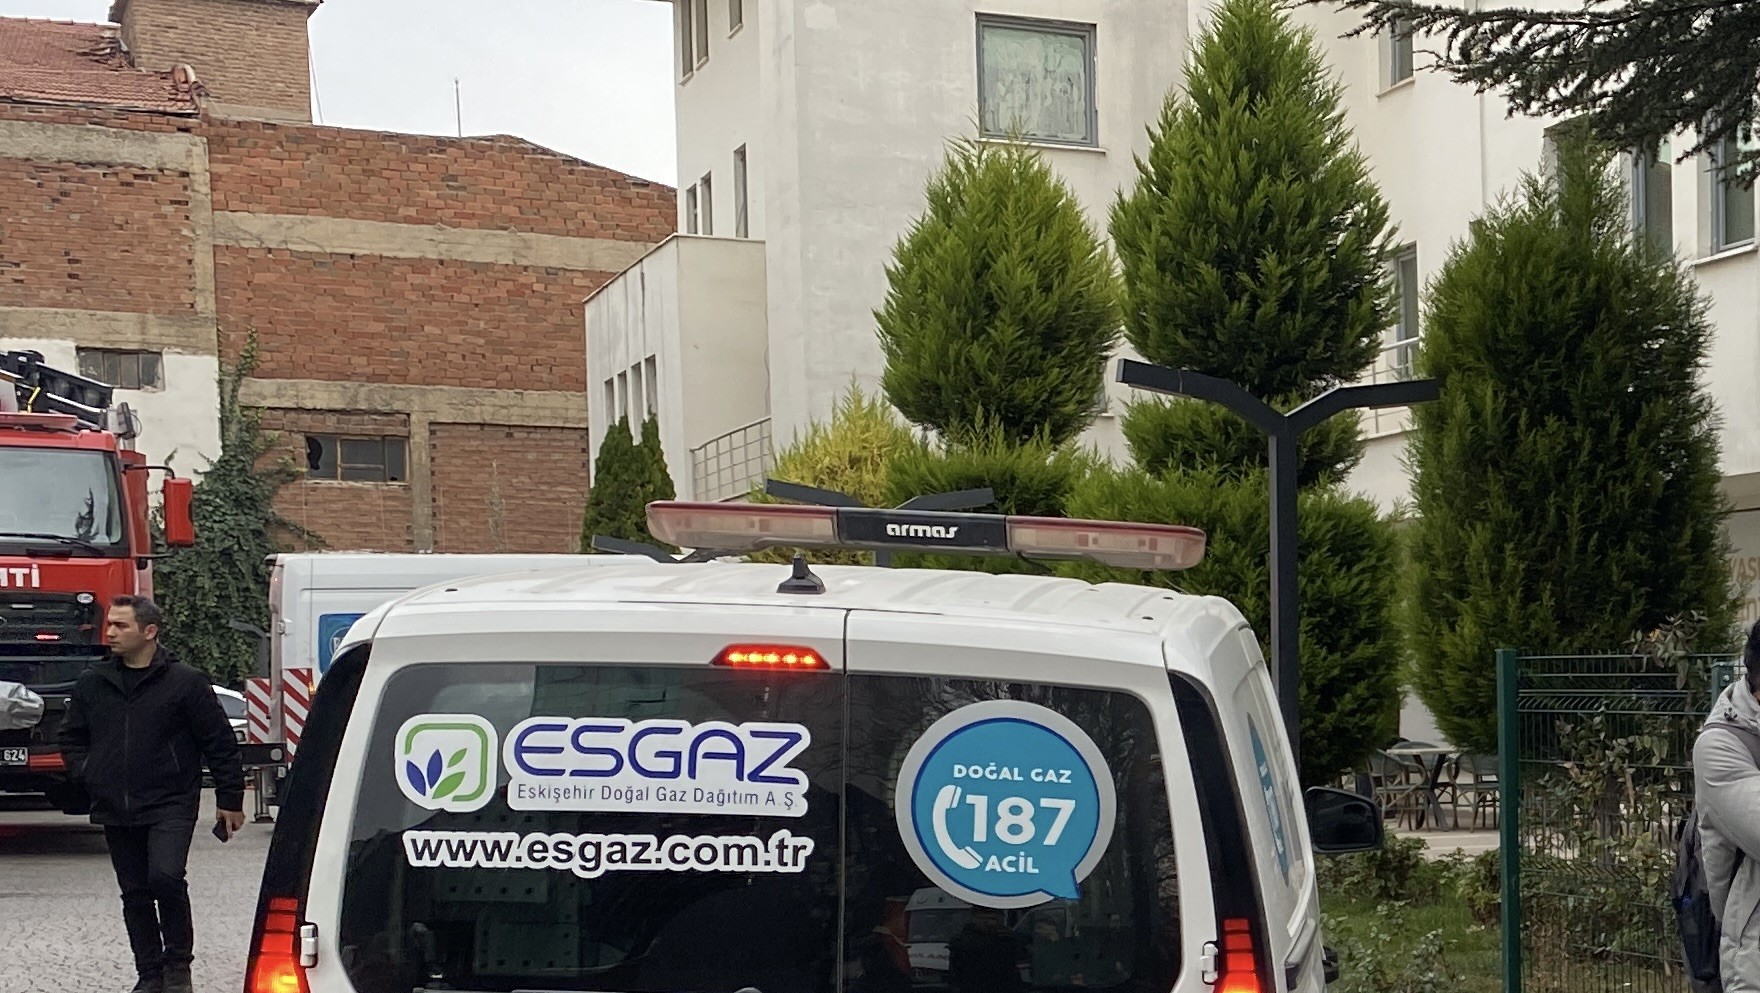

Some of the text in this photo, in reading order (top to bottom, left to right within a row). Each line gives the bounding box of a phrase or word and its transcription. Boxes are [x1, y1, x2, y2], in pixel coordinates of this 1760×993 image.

[886, 523, 958, 540] armas
[514, 723, 802, 785] ESGAZ
[953, 762, 1072, 784] DOĞAL GAZ
[517, 783, 595, 804] Eskişehir
[601, 785, 649, 804] Doğal
[656, 786, 687, 802] Gaz
[693, 787, 759, 807] Dağıtım
[965, 794, 1076, 846] 187
[410, 837, 807, 872] www.esgaz.com.tr
[984, 851, 1040, 874] ACİL
